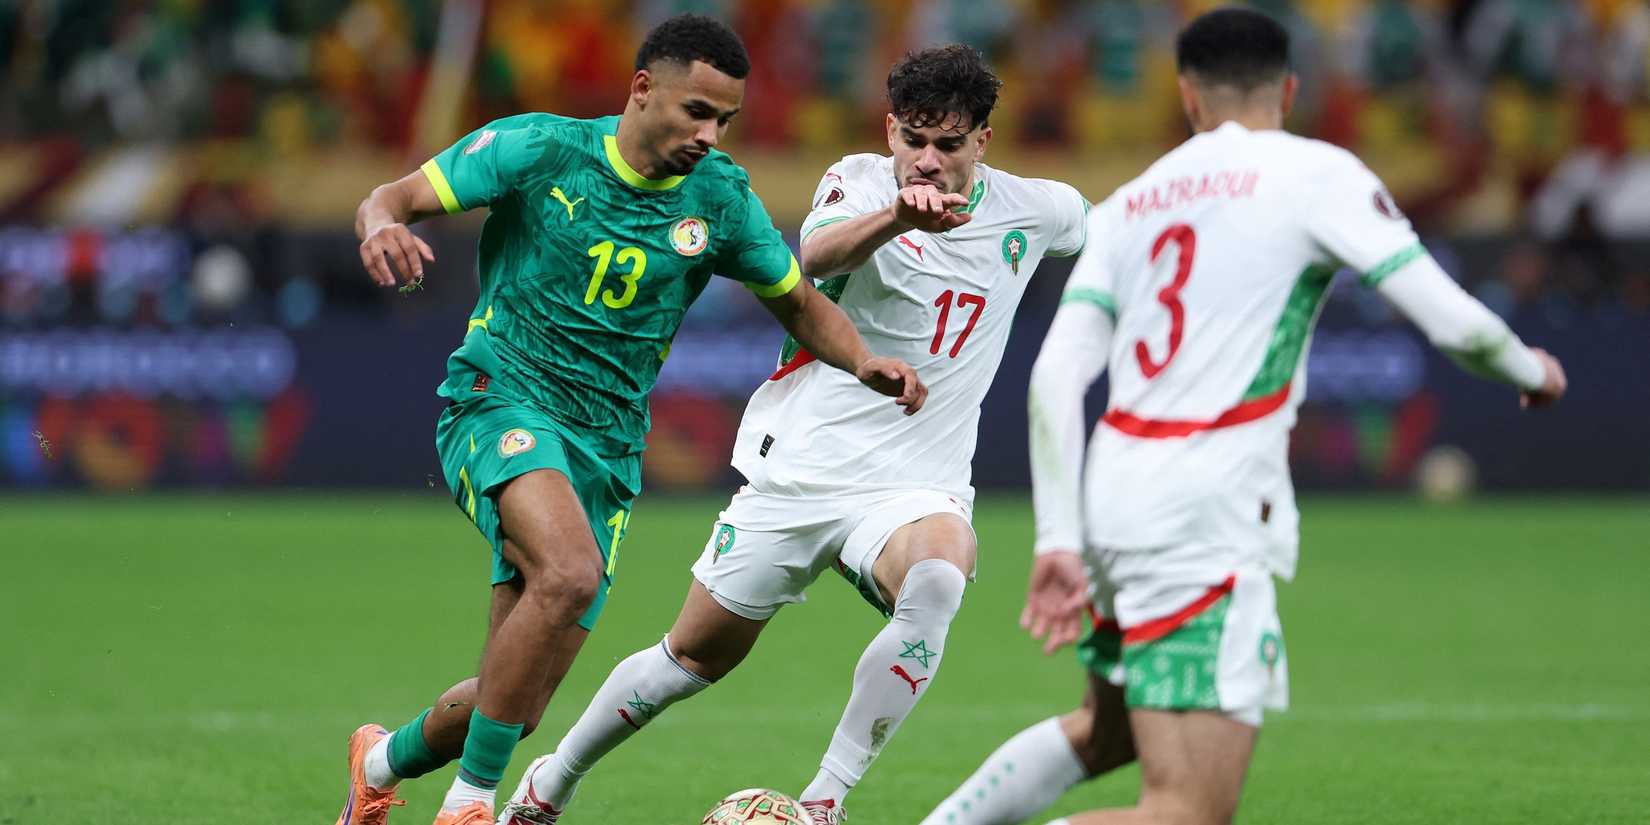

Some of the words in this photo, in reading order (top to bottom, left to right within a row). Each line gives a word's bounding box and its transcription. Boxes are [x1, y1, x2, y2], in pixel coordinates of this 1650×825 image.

[1126, 170, 1258, 220] MAZRAOUI
[584, 240, 647, 309] 13
[1135, 223, 1196, 379] 3
[929, 289, 986, 359] 17
[607, 509, 631, 577] 1
